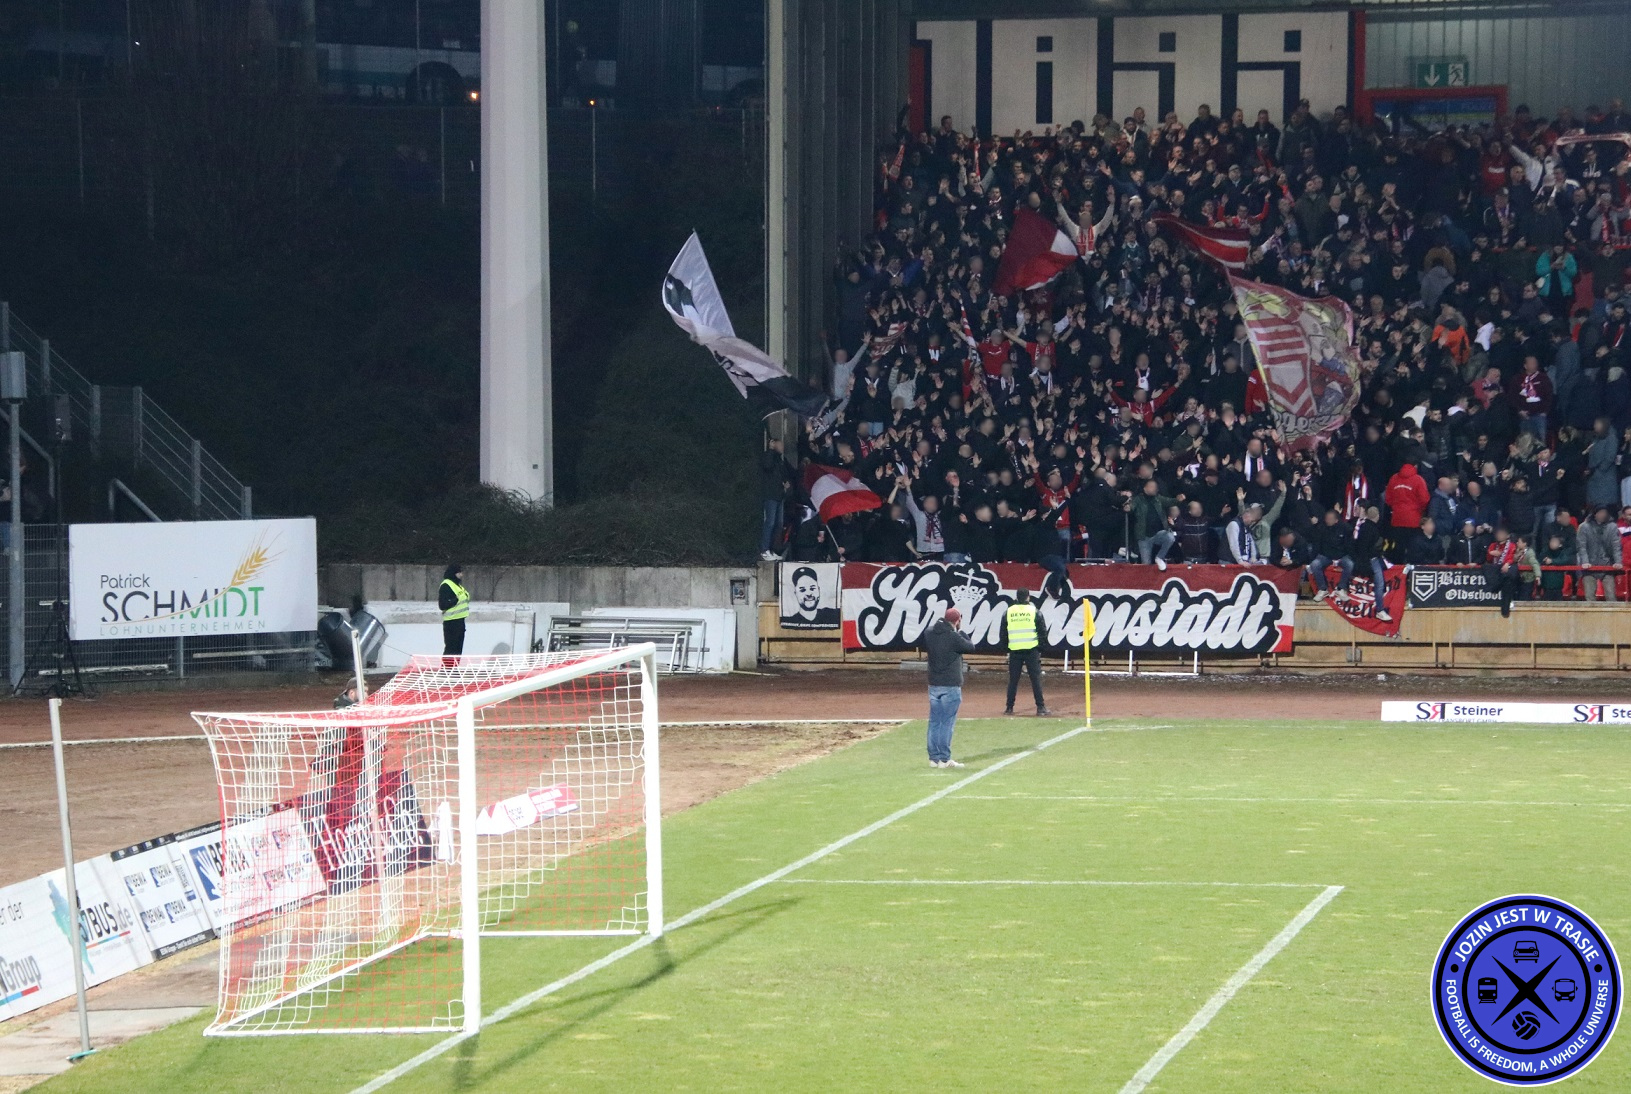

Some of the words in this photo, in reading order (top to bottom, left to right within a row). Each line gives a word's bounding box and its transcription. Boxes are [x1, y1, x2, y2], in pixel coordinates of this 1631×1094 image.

[100, 573, 151, 589] Patrick
[1438, 571, 1487, 587] Bären
[101, 586, 265, 623] SCHMIDT
[100, 620, 266, 637] LOHNUNTERNEHMEN
[1454, 705, 1504, 716] Steiner
[7, 898, 25, 922] der
